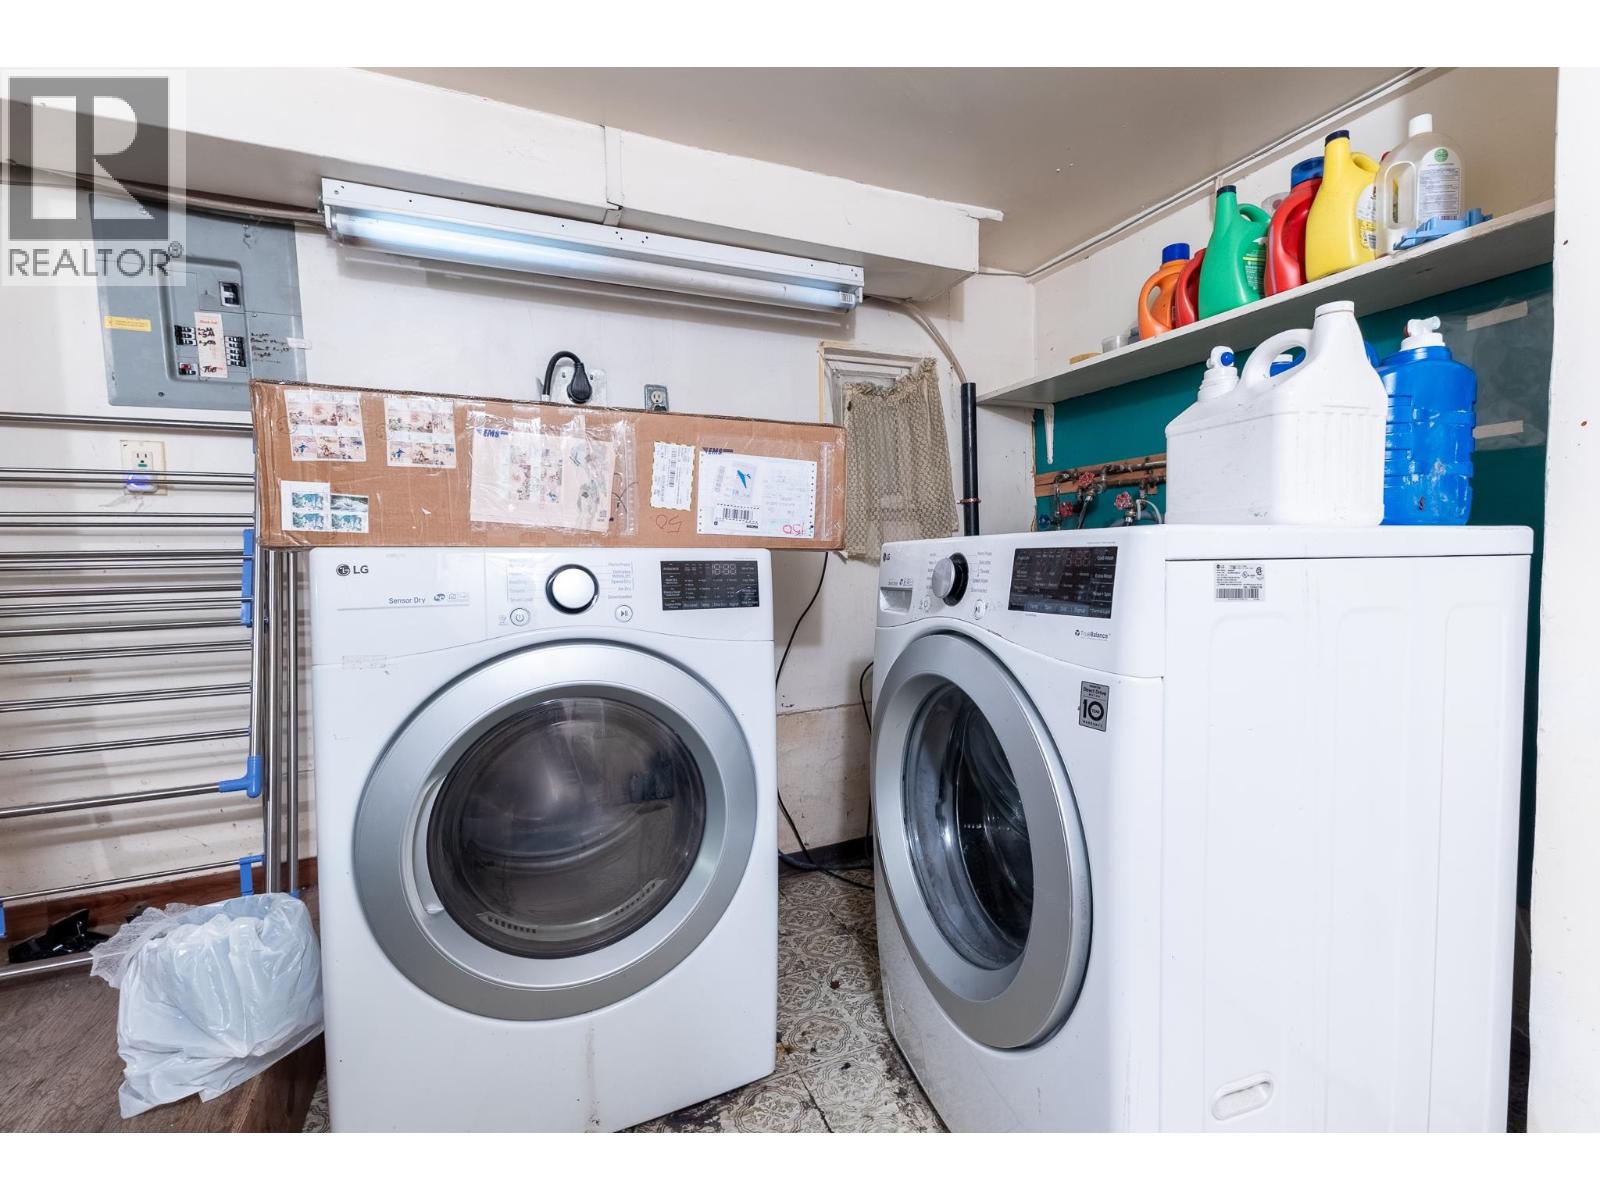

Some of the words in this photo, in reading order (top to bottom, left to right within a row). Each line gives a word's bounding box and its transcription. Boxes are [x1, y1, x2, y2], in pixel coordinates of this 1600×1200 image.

[483, 429, 500, 438] EMS
[353, 565, 369, 574] LG
[388, 596, 413, 605] Sensor
[414, 596, 426, 604] Dry
[1082, 698, 1105, 722] 10
